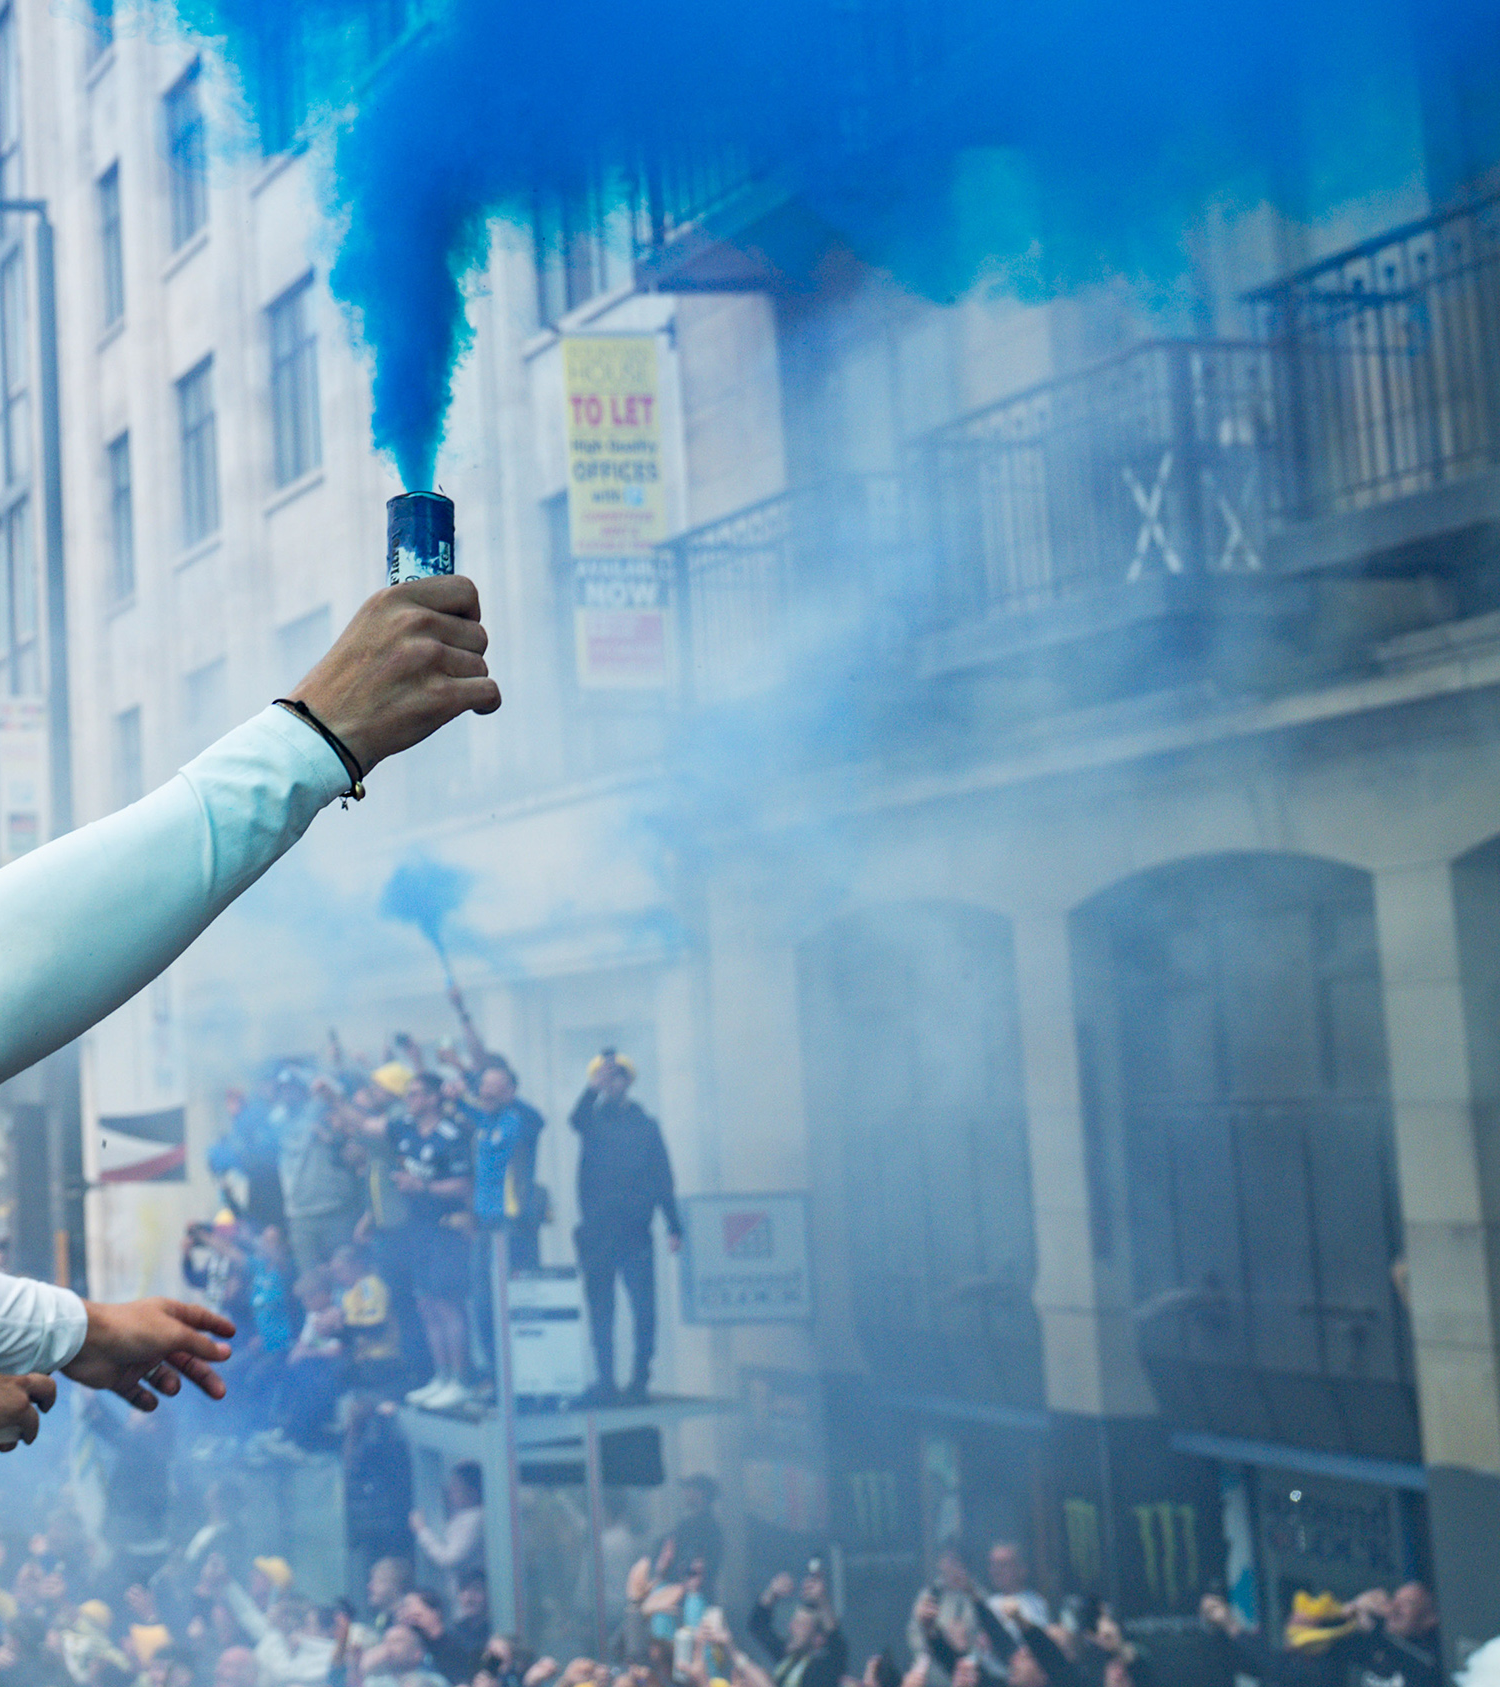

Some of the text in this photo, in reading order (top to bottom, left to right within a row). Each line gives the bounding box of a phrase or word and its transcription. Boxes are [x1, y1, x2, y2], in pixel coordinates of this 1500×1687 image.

[570, 393, 654, 427] TO LET
[573, 460, 659, 483] OFFICES
[583, 582, 659, 601] NOW
